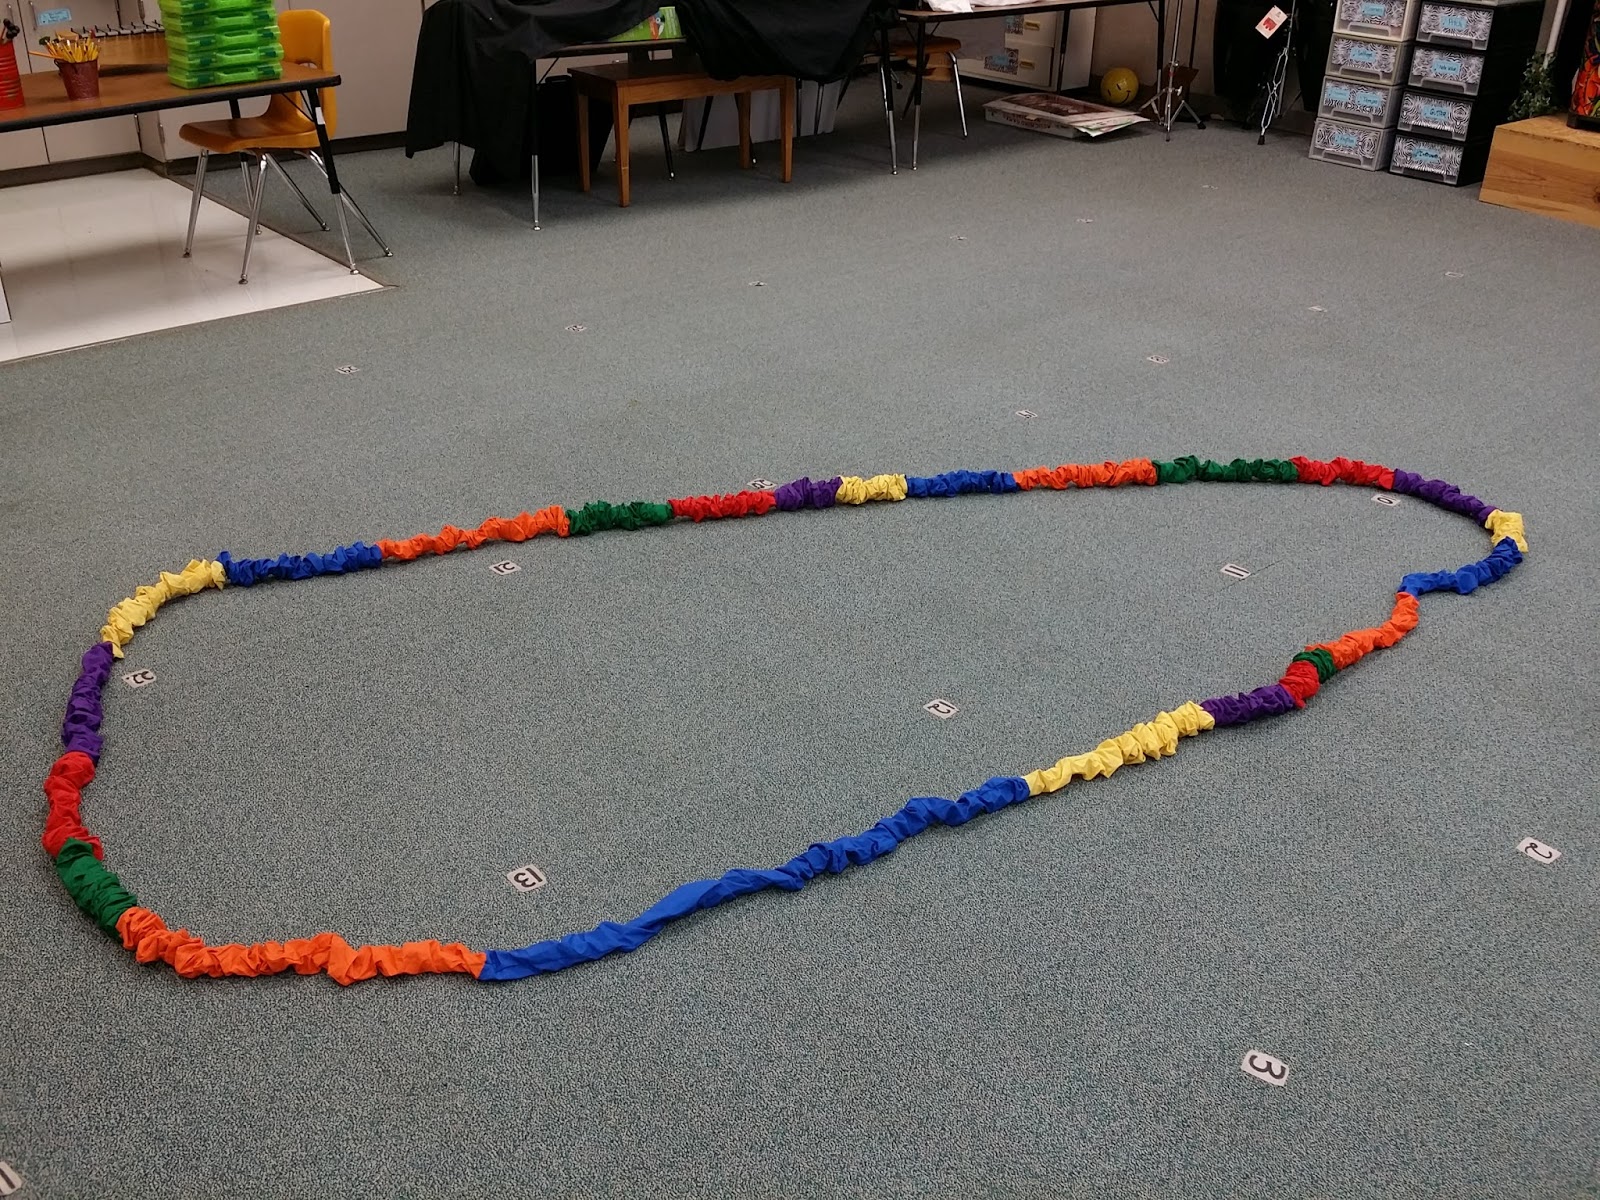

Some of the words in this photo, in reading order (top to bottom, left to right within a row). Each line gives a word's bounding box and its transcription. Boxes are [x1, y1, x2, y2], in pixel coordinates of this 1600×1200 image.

[493, 562, 515, 573] 21
[1224, 565, 1250, 577] 11
[927, 701, 956, 714] 12
[1525, 843, 1553, 859] 2
[514, 868, 543, 887] 13
[1249, 1055, 1287, 1080] 3
